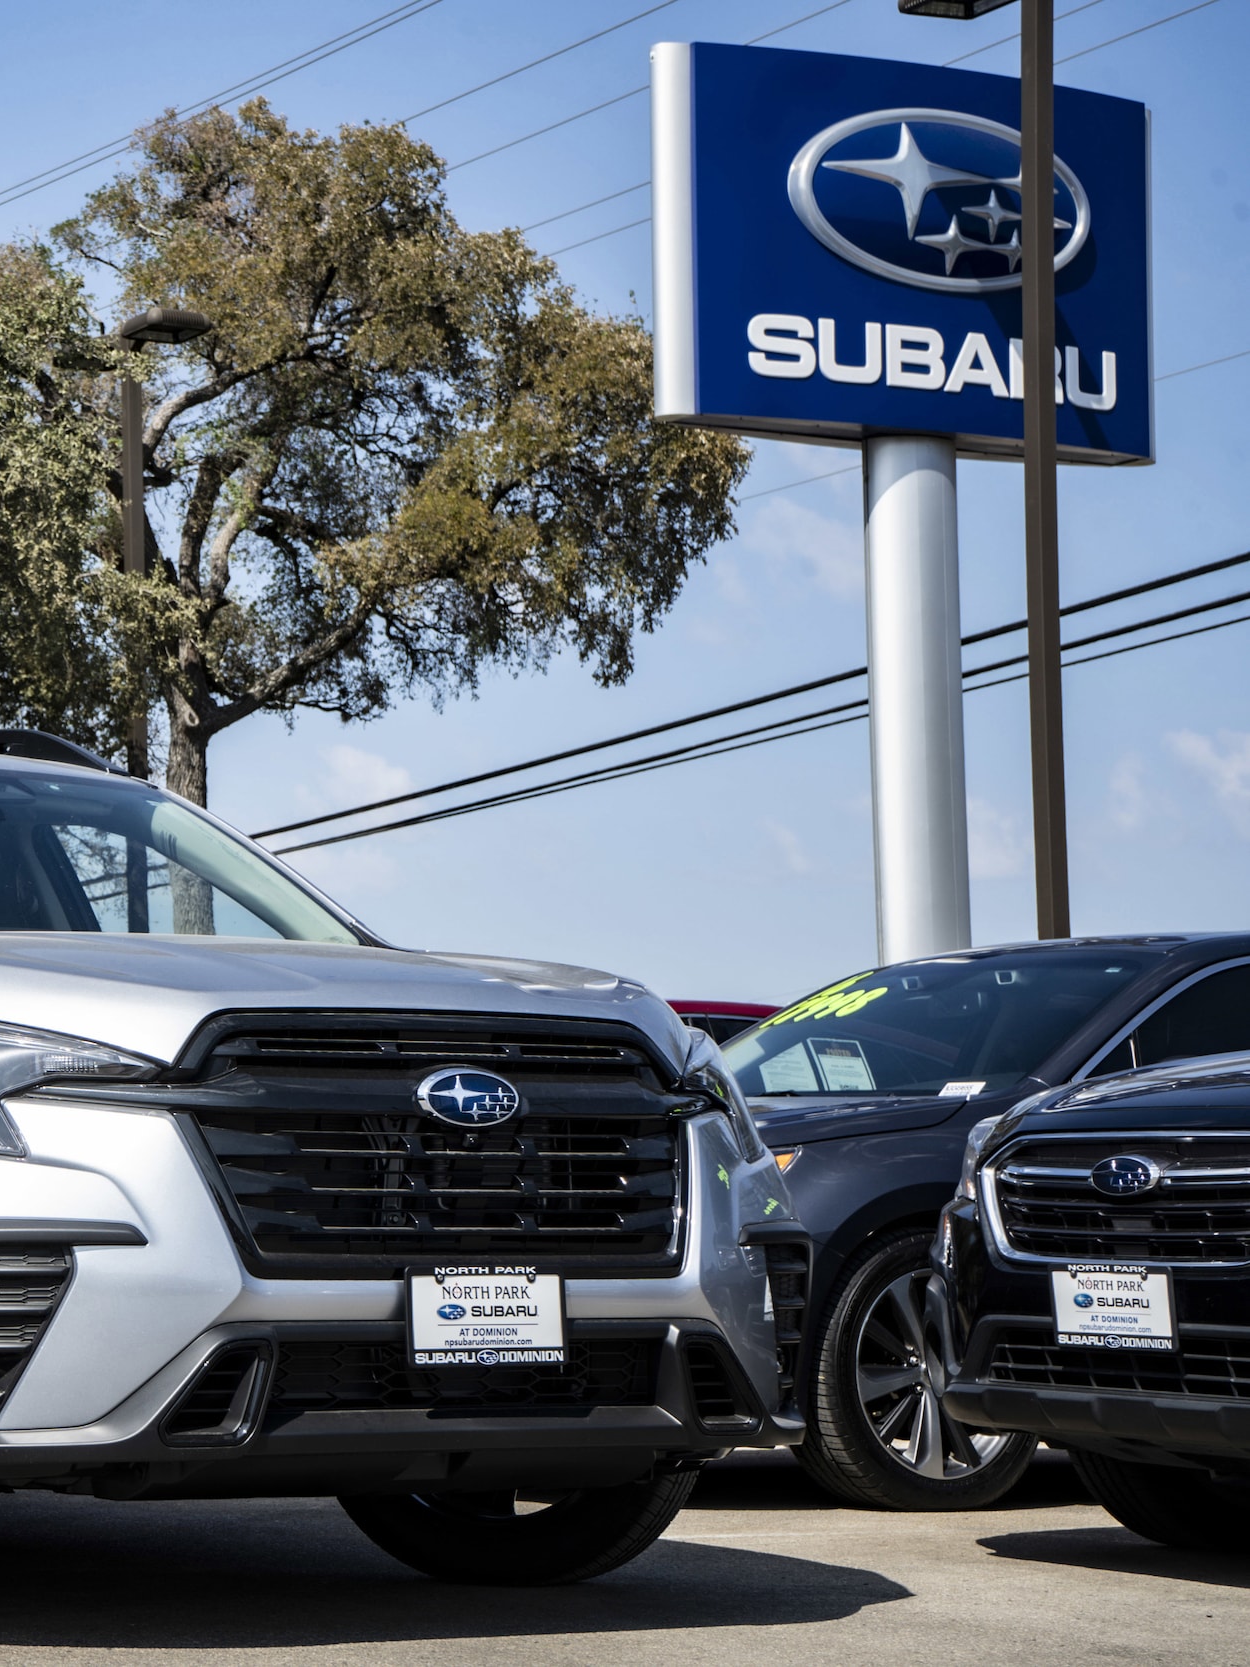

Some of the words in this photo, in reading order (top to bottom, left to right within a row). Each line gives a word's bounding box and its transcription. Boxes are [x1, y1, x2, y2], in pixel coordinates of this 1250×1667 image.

[434, 1267, 491, 1275] NORTH
[495, 1266, 537, 1274] PARK
[1068, 1264, 1109, 1272] NORTH
[1114, 1265, 1147, 1273] PARK
[1078, 1279, 1113, 1290] NORTH
[1117, 1281, 1145, 1291] PARK
[442, 1286, 490, 1299] NORTH
[495, 1286, 531, 1299] PARK
[1097, 1297, 1149, 1308] SUBARU
[471, 1305, 538, 1317] SUBARU
[459, 1328, 470, 1336] AT
[472, 1328, 518, 1336] DOMINION
[1079, 1324, 1152, 1333] npsubarudominion.com
[444, 1338, 532, 1348] npsubarudominion.com
[1058, 1334, 1104, 1345] SUBARU
[1122, 1337, 1172, 1349] DOMINION
[415, 1351, 477, 1364] SUBARU
[499, 1350, 564, 1363] DOMINION
